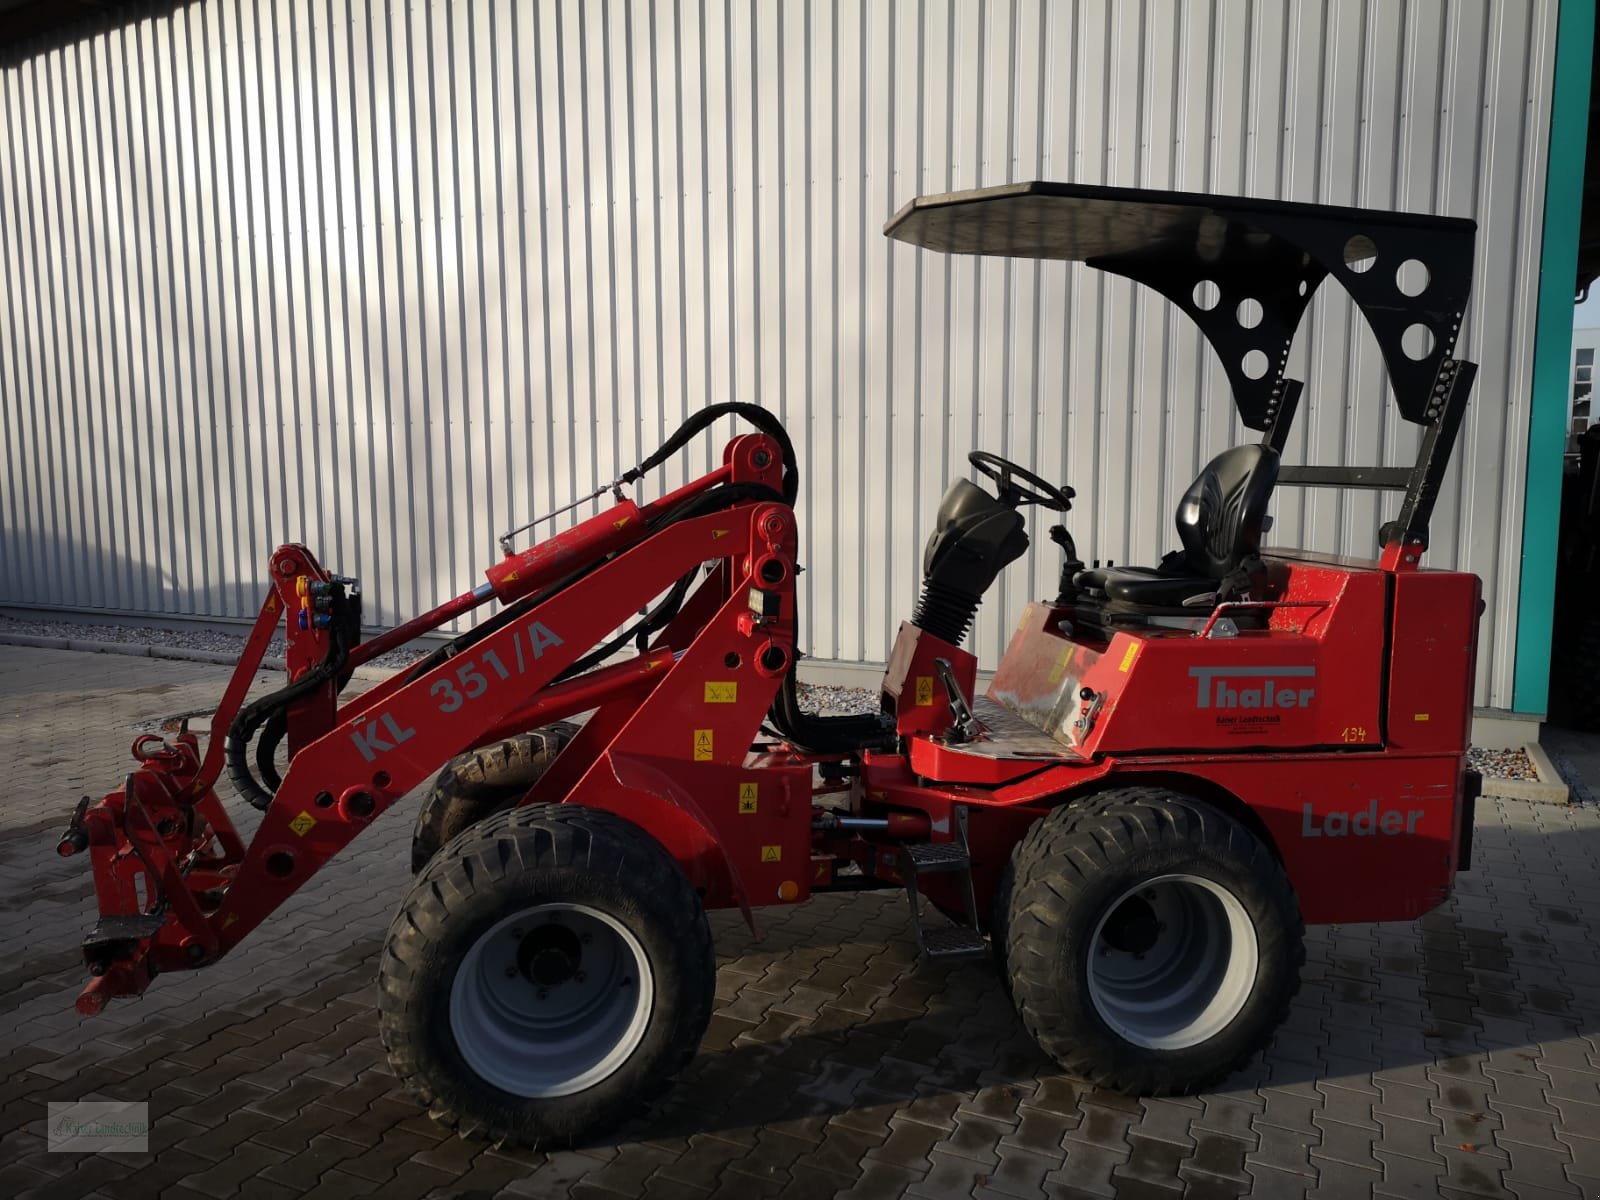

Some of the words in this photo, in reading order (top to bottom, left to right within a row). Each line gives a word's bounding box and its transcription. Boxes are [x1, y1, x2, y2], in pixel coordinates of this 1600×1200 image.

[351, 712, 416, 762] KL
[430, 620, 564, 713] 351/A
[1188, 666, 1316, 708] Thaler
[1341, 727, 1366, 742] 134
[1302, 799, 1424, 837] Lader
